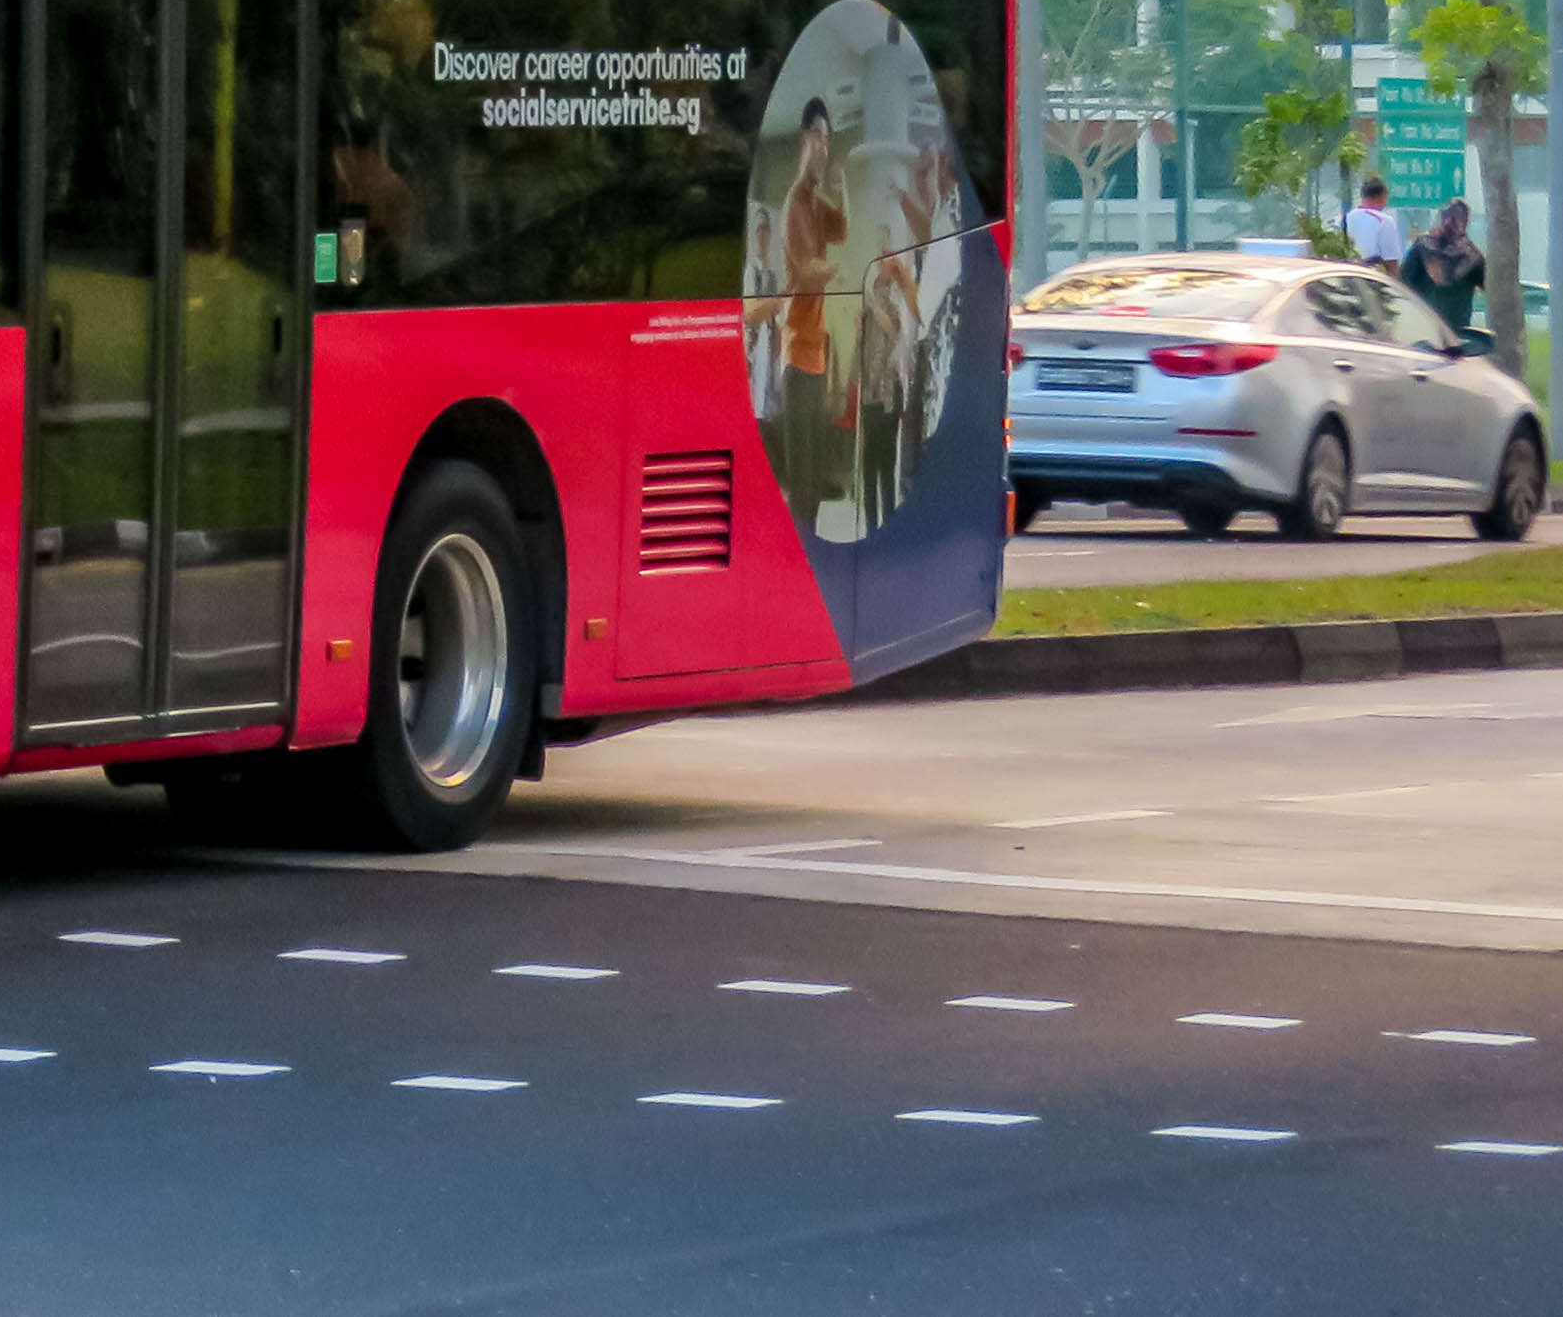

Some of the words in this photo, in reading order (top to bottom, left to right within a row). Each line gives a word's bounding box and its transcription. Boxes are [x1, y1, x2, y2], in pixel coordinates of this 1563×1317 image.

[434, 41, 520, 82] Discover
[524, 51, 590, 82] career
[595, 43, 722, 89] opportunities
[726, 47, 747, 81] at
[482, 86, 702, 136] socialservicetribe.sg
